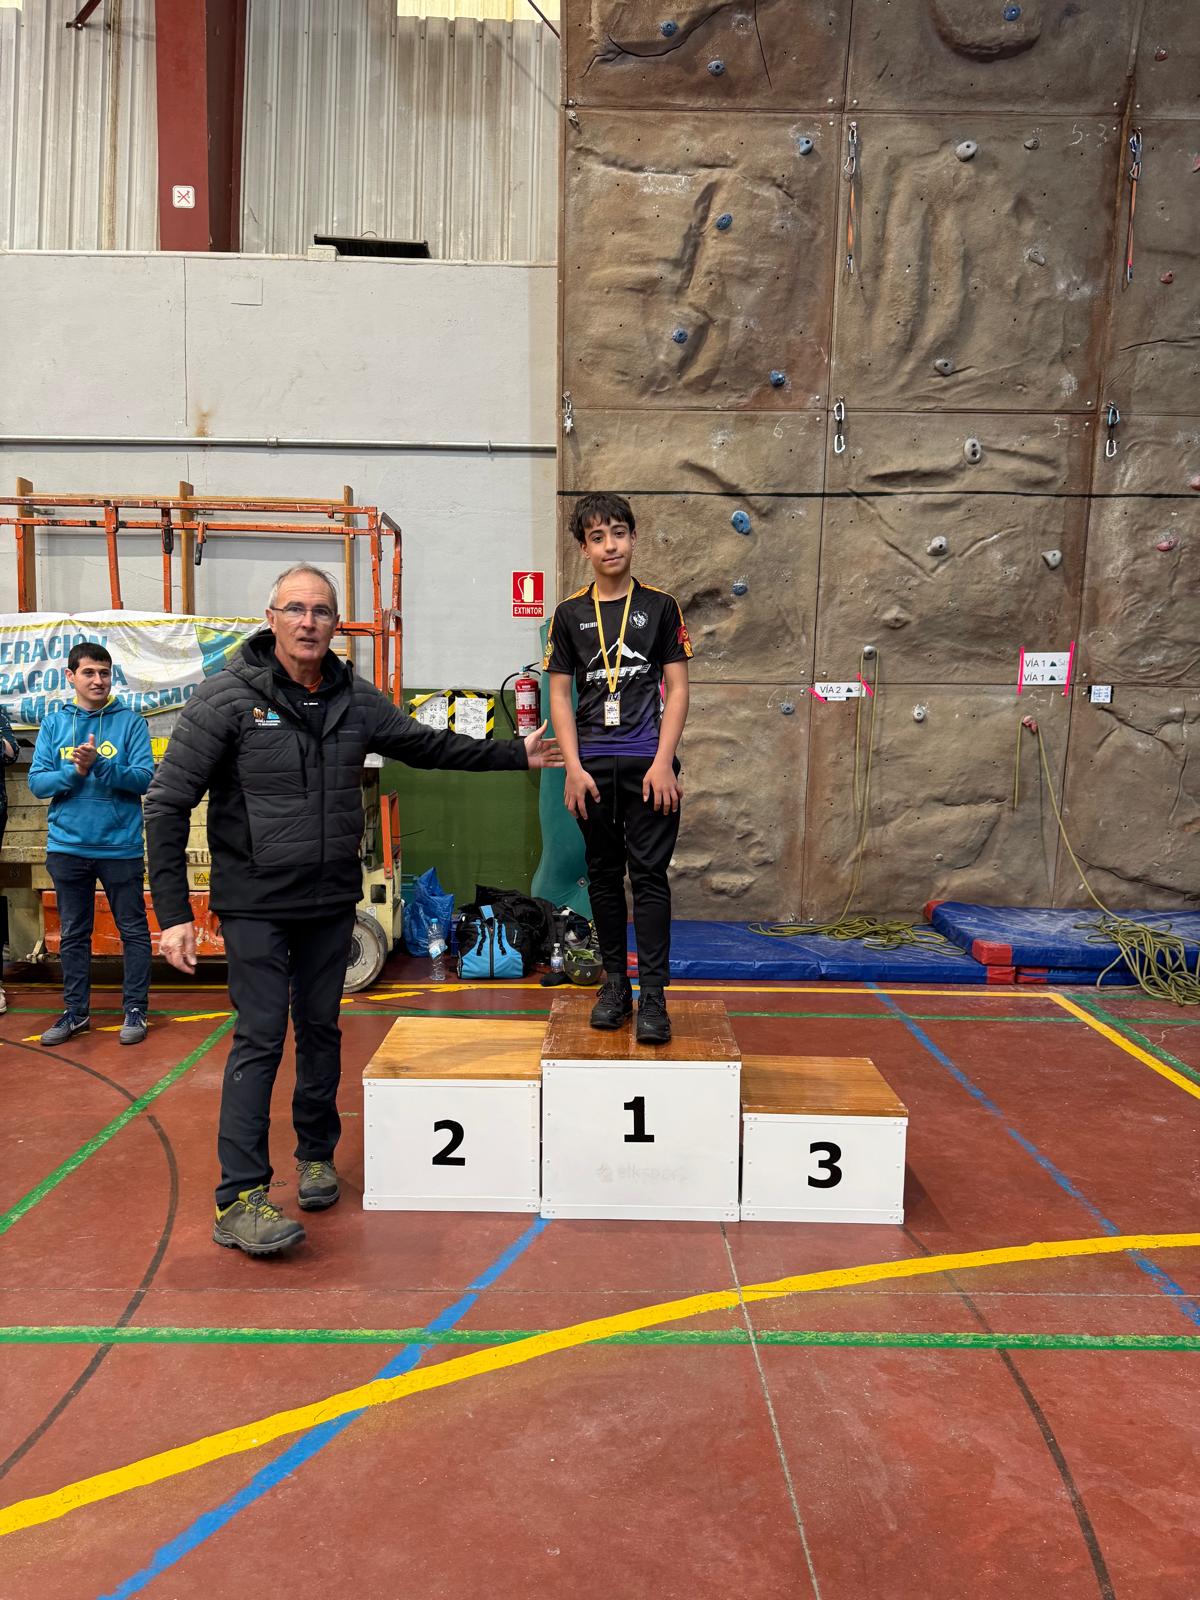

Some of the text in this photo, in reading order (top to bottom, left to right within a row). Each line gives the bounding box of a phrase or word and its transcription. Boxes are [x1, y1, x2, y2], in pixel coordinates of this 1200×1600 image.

[514, 606, 543, 616] EXTINTOR
[1024, 672, 1045, 682] VÍA 1
[1025, 657, 1046, 668] VÍA 1
[0, 664, 128, 695] RAGOA
[820, 684, 842, 694] VÍA 2
[21, 683, 199, 724] MOÑISMO
[623, 1096, 655, 1143] 1
[431, 1119, 466, 1167] 2
[807, 1141, 843, 1189] 3
